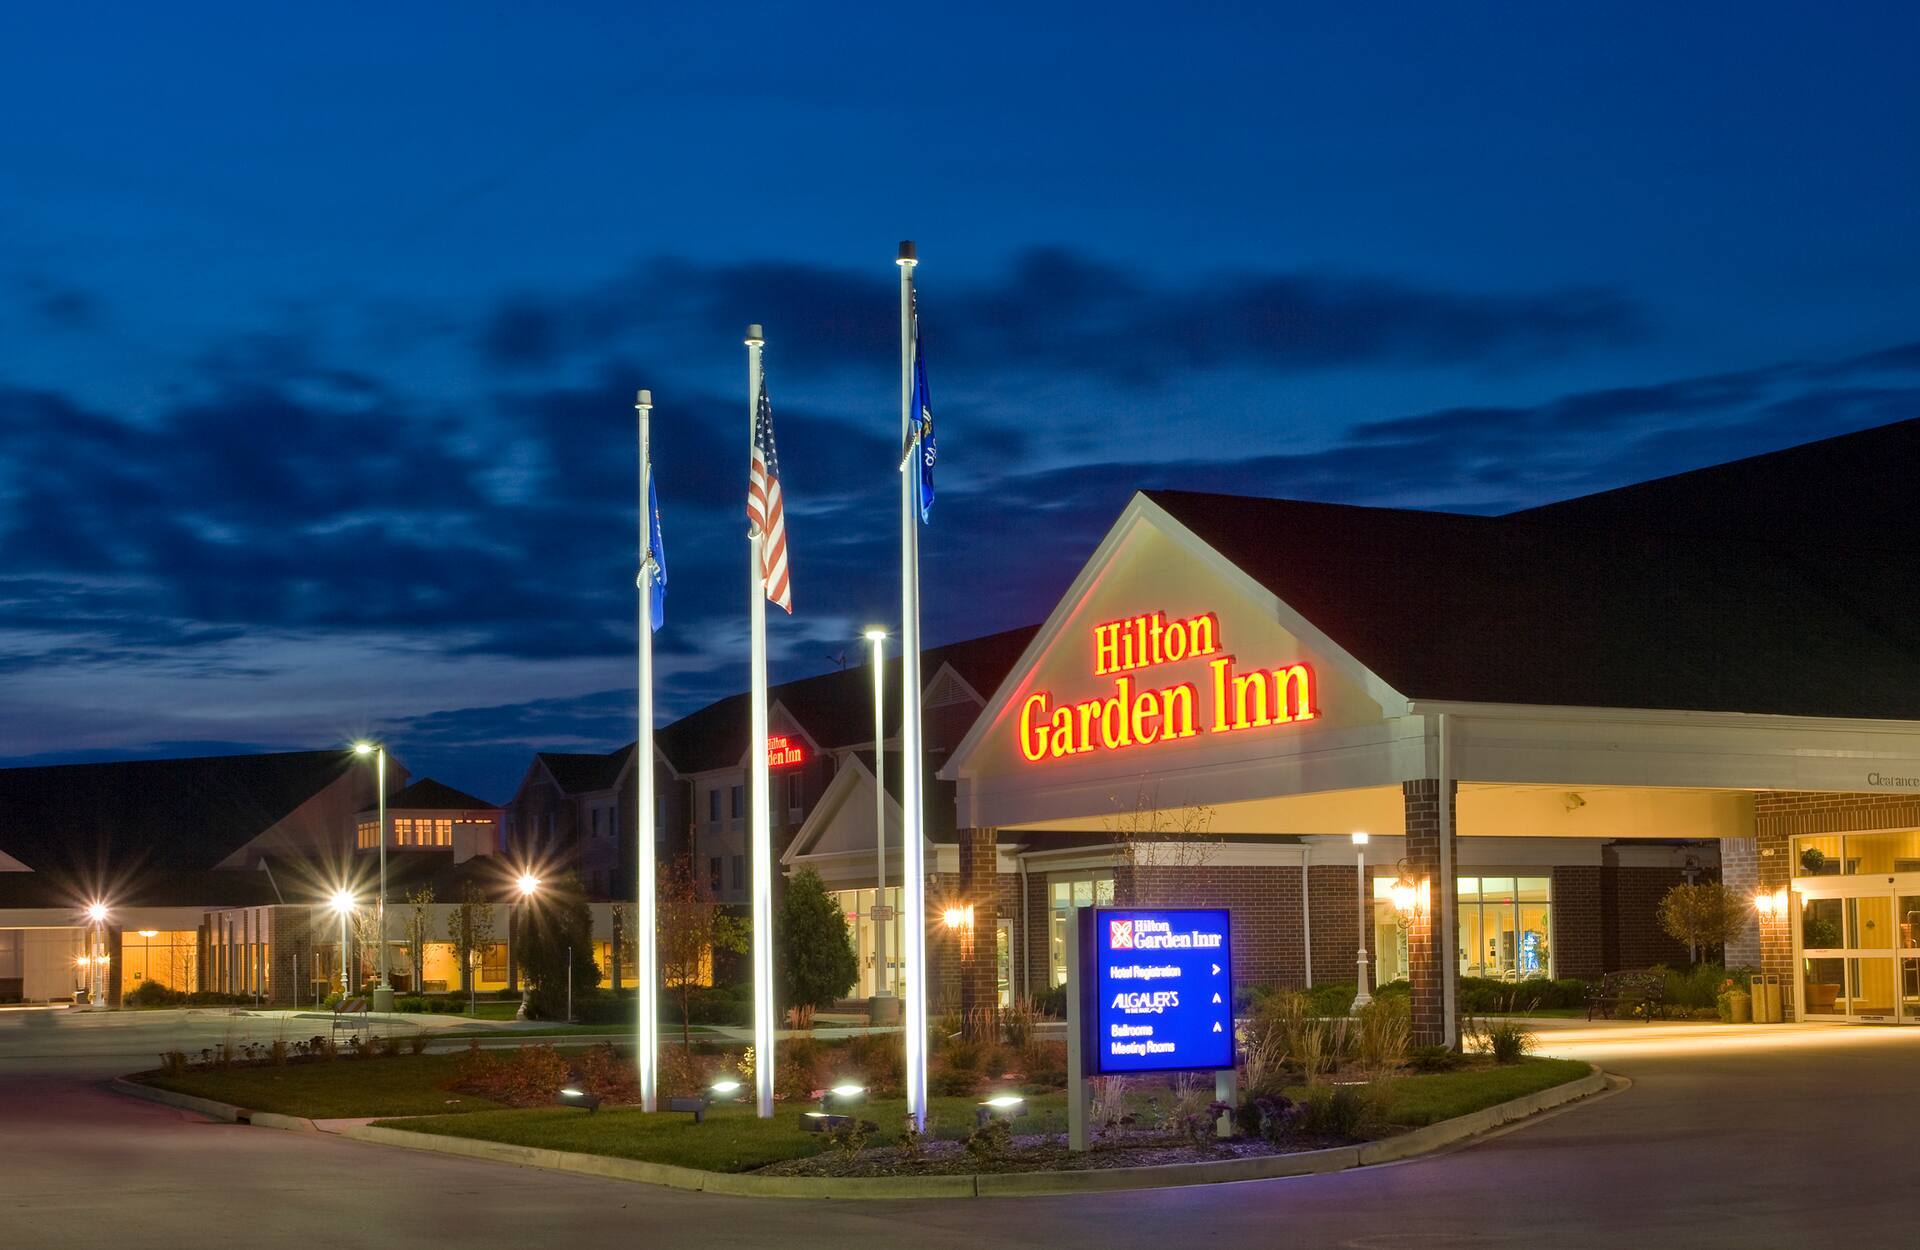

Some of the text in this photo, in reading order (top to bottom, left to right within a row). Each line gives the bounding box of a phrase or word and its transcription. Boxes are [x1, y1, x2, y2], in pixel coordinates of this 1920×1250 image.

[1094, 611, 1221, 676] Hilton
[1019, 655, 1319, 762] Garden Inn
[785, 747, 801, 762] Inn
[1867, 772, 1920, 788] Clearance
[1134, 920, 1170, 932] Hilton
[1134, 931, 1220, 949] Garden Inn
[1110, 965, 1181, 980] Hotel Registration
[1111, 1023, 1154, 1037] Ballrooms
[1111, 1040, 1176, 1057] Meeting Rooms
